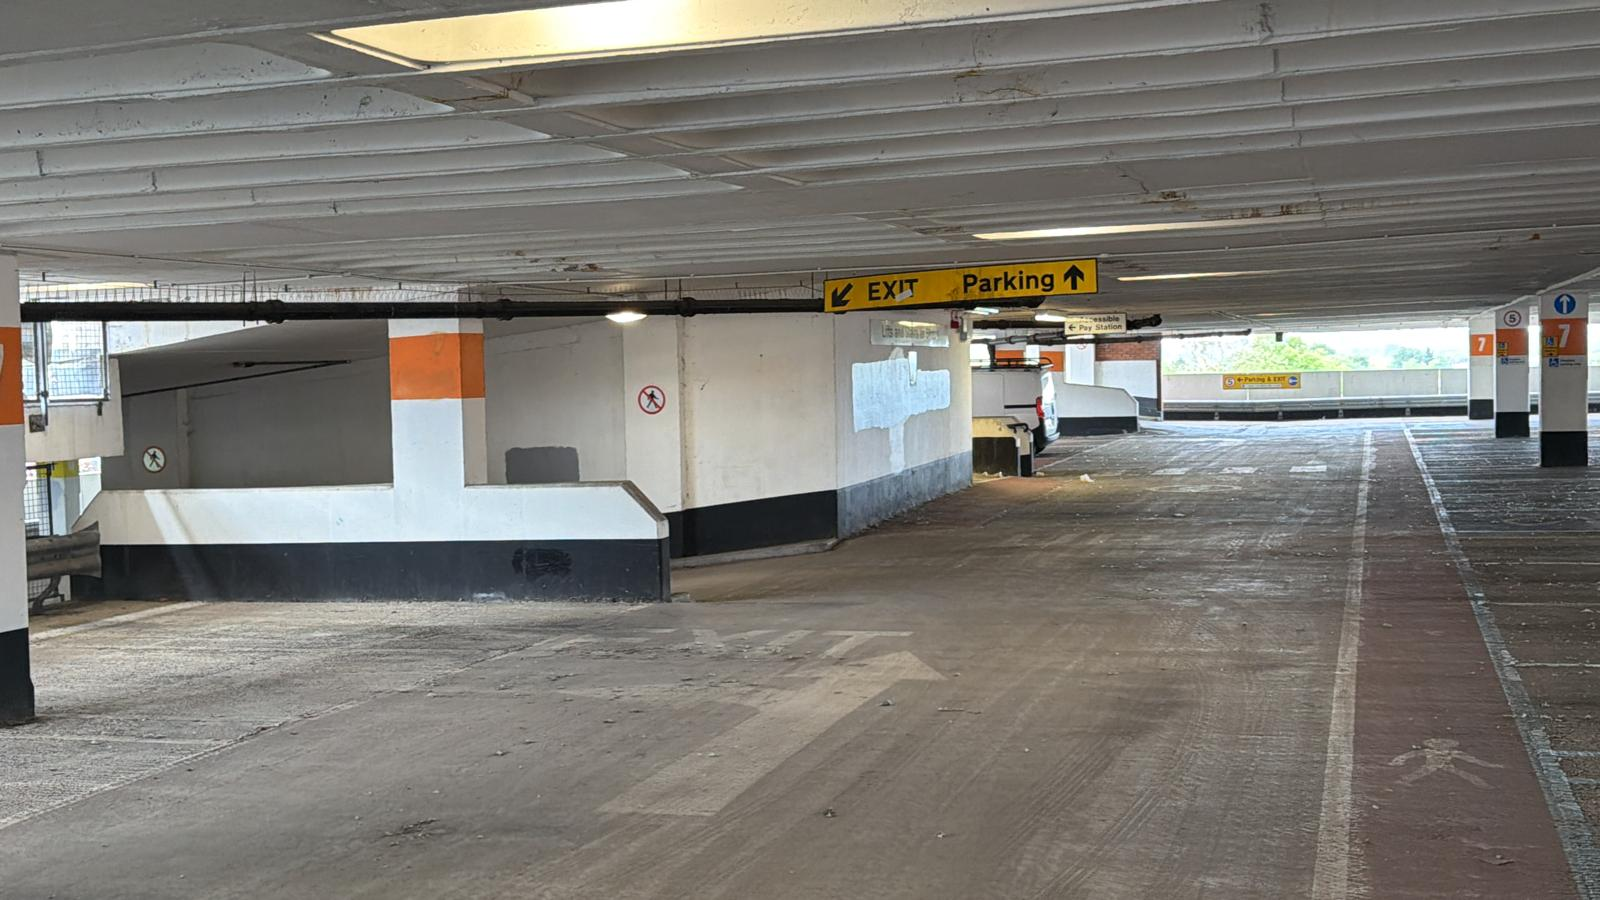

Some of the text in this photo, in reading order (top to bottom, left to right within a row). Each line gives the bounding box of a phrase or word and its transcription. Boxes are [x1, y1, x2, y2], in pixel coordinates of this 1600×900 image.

[868, 279, 918, 301] EXIT
[962, 270, 1055, 293] Parking
[1080, 315, 1120, 323] cessible
[1509, 314, 1517, 323] 5
[1478, 337, 1486, 352] 7
[1559, 324, 1570, 348] 7
